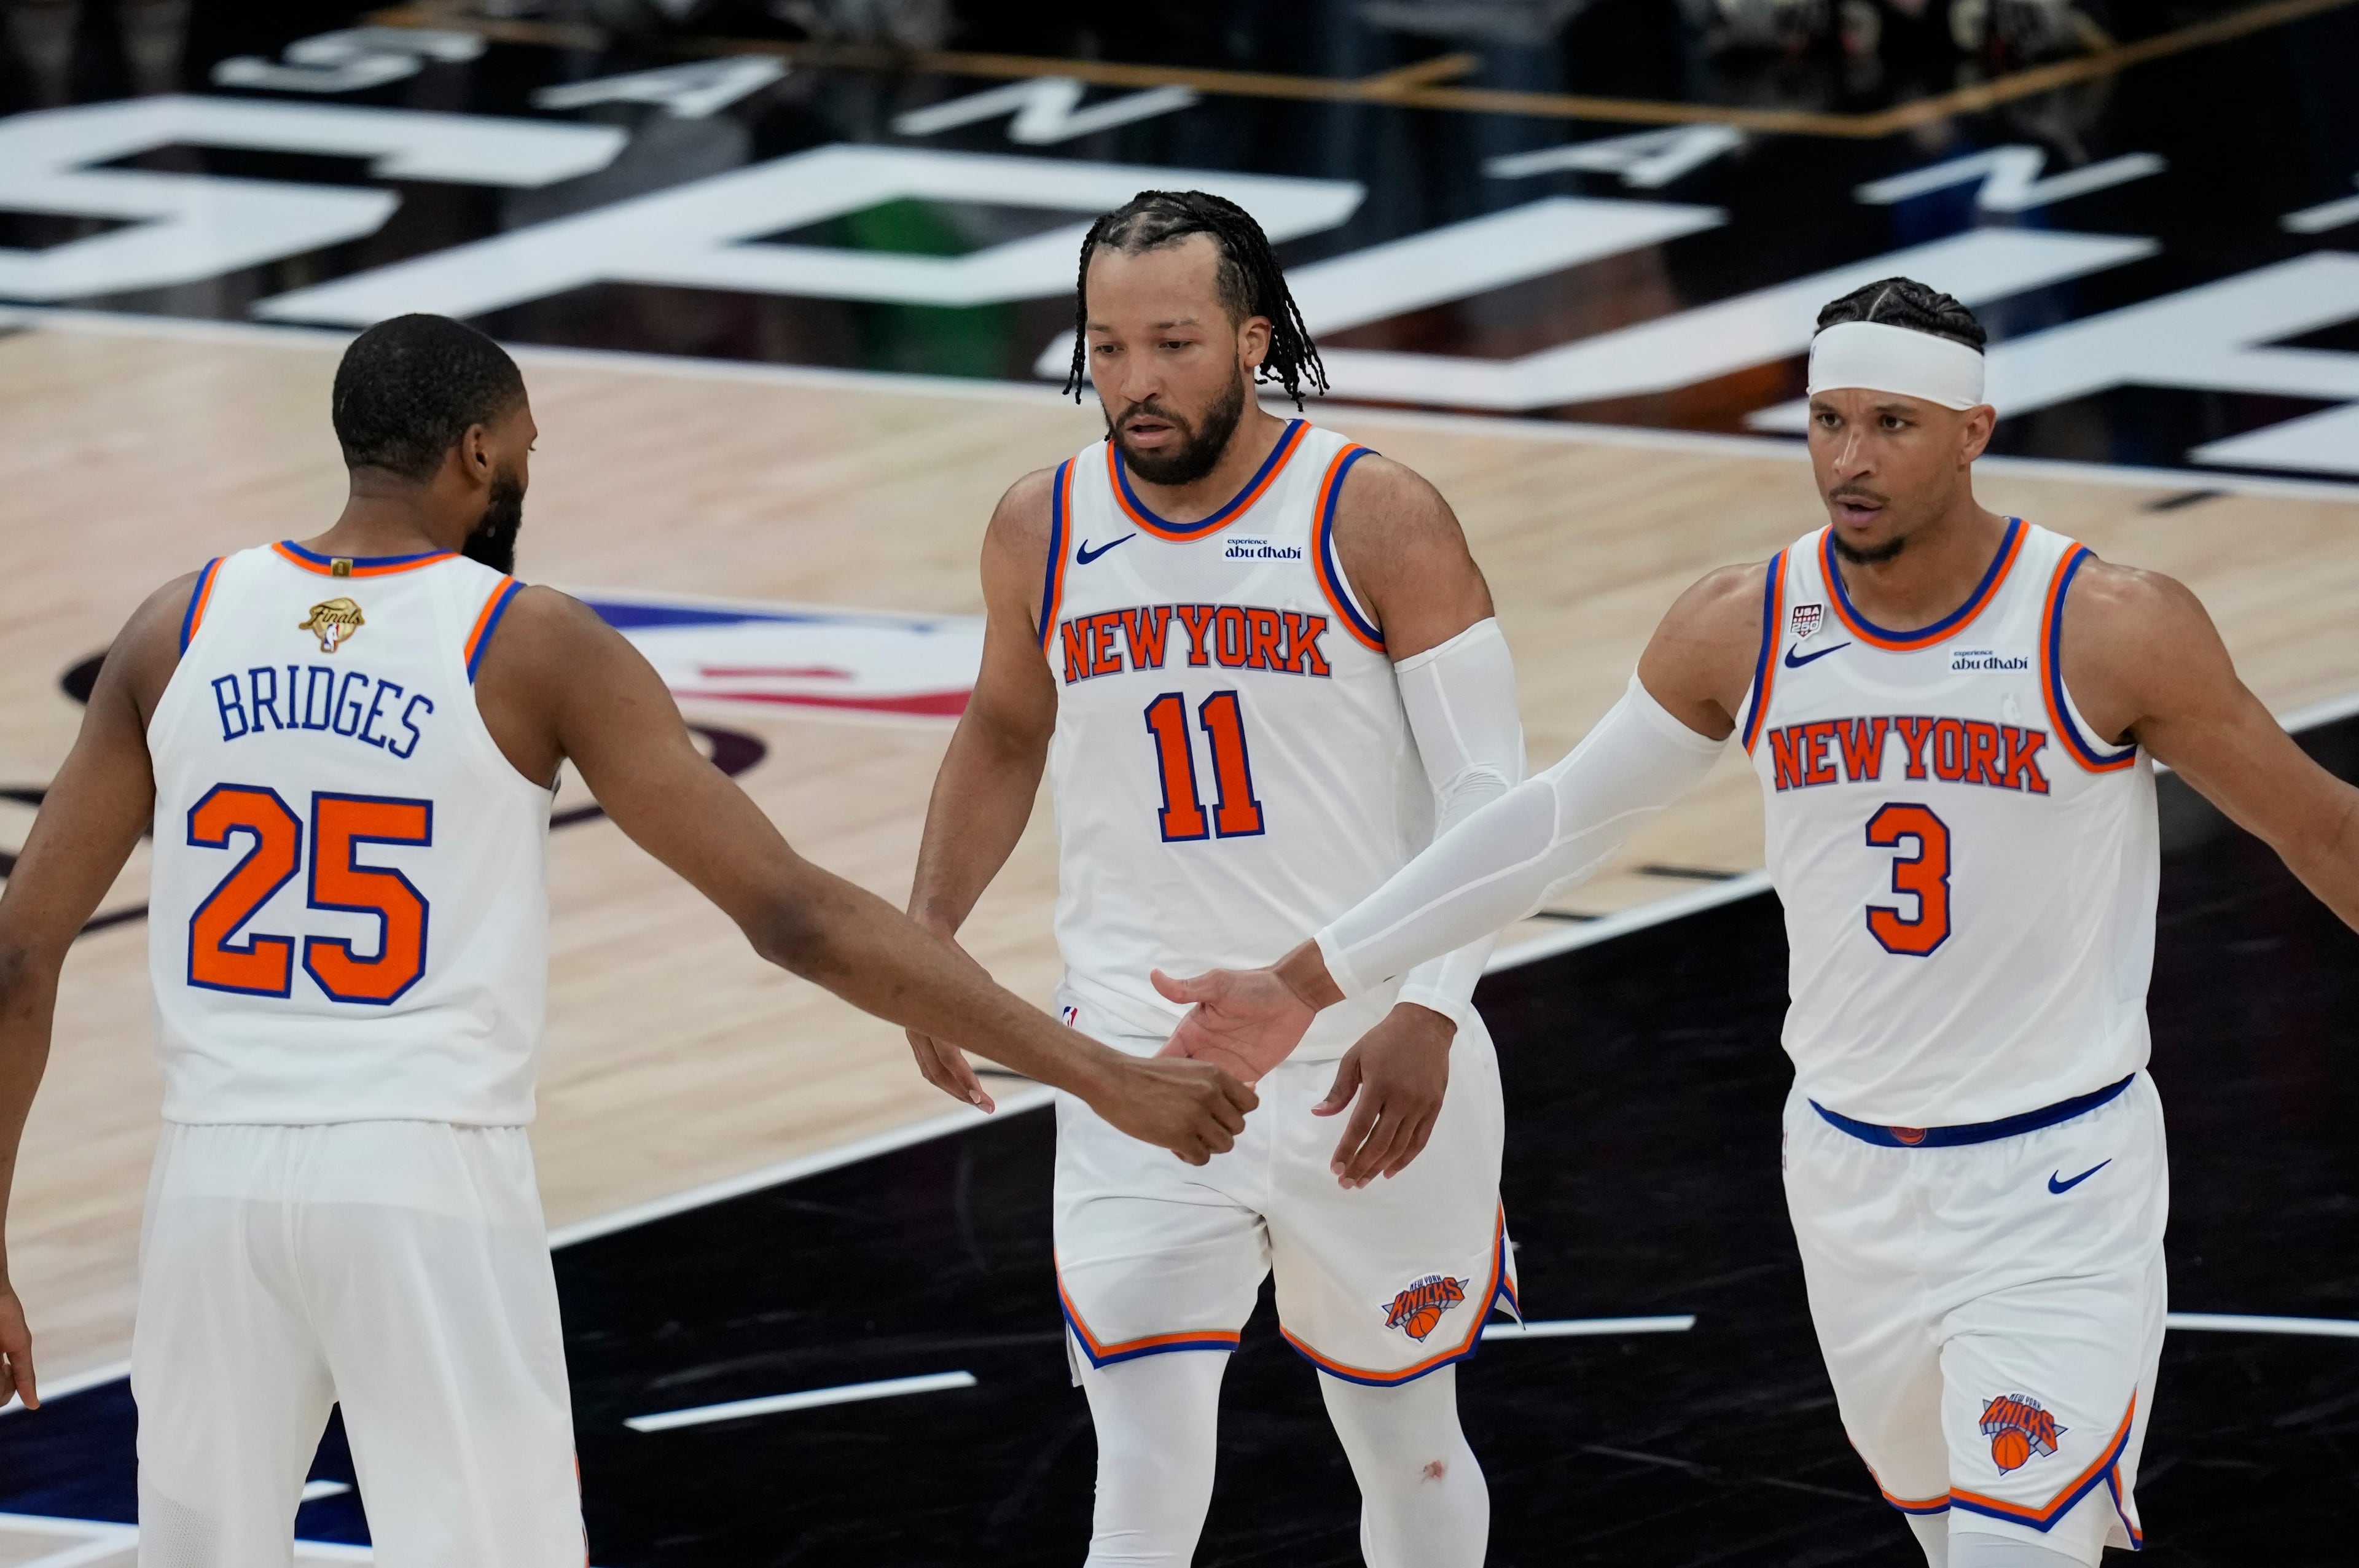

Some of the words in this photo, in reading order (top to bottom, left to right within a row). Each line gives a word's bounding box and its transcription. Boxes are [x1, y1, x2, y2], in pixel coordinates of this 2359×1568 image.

[211, 26, 1199, 146] SAN
[1225, 545, 1254, 558] abu
[299, 604, 365, 629] Finals
[1791, 620, 1819, 633] 250
[1795, 606, 1820, 617] USA
[1060, 604, 1172, 686] NEW
[1175, 603, 1332, 679] YORK
[1952, 657, 1980, 670] abu
[211, 665, 434, 759] BRIDGES
[1143, 690, 1266, 843] 11
[1766, 715, 1892, 794] NEW
[1893, 715, 2051, 797] YORK
[187, 782, 433, 1006] 25
[1865, 802, 1951, 958] 3
[1385, 1277, 1465, 1327] KNICKS
[1410, 1278, 1423, 1291] NEW
[1424, 1274, 1442, 1285] YORK
[1979, 1395, 2058, 1452] KNICKS
[2009, 1394, 2025, 1402] NEW
[2026, 1395, 2042, 1411] YORK
